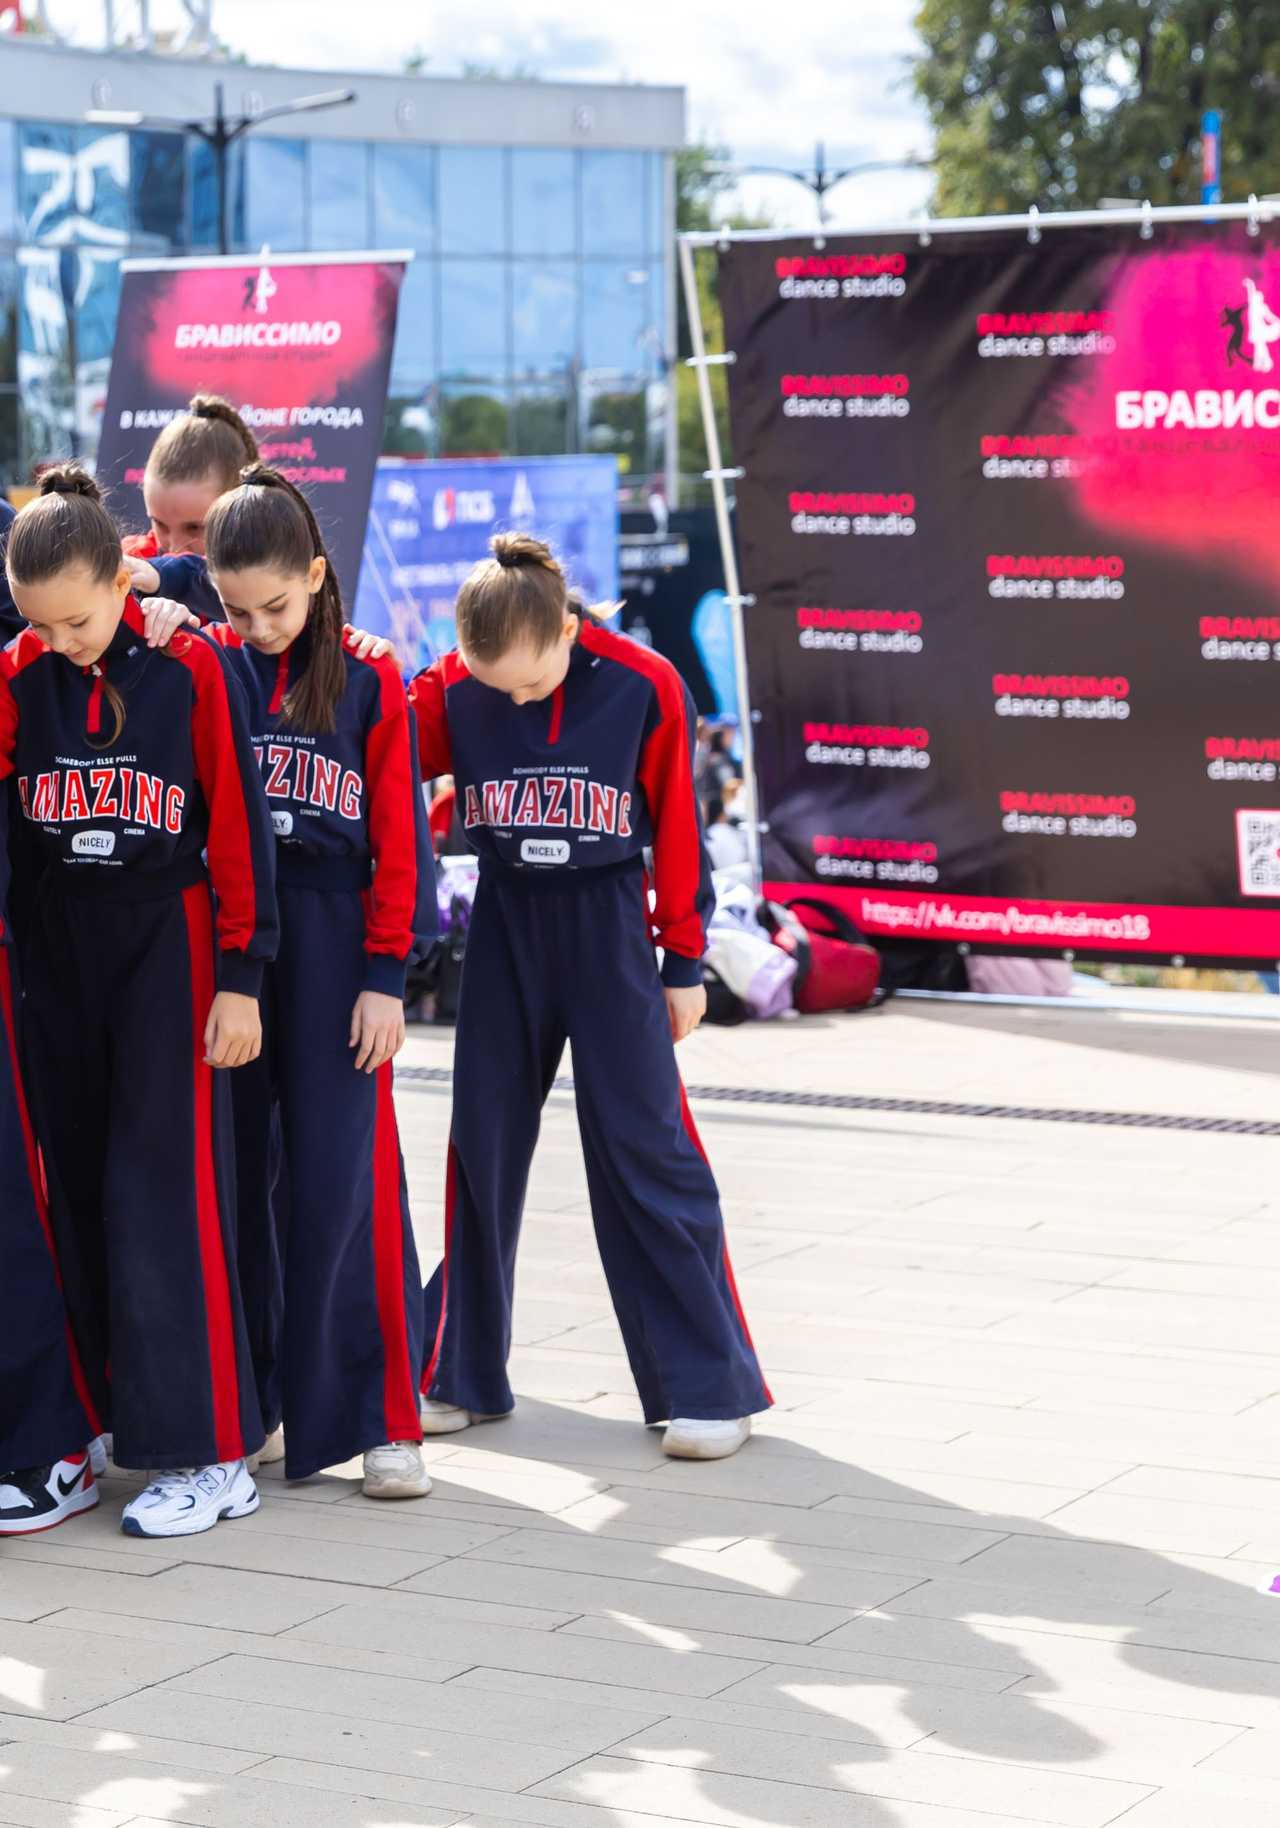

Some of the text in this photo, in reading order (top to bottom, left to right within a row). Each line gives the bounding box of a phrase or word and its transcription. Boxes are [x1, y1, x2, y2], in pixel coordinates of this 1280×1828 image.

[779, 275, 906, 299] dance studio
[174, 320, 342, 348] БРАВИССИМО
[978, 332, 1117, 357] dance studio
[120, 410, 133, 429] В
[238, 403, 289, 427] ЙОНЕ
[288, 406, 364, 430] ГОРОДА
[783, 393, 910, 417] dance studio
[1115, 388, 1280, 430] БРАВИС
[982, 455, 1049, 479] dance
[791, 511, 916, 536] dance studio
[988, 574, 1125, 600] dance studio
[799, 626, 923, 653] dance studio
[1201, 635, 1271, 661] dance
[994, 693, 1131, 720] dance studio
[276, 735, 293, 743] ELSE
[294, 736, 316, 745] PULLS
[96, 757, 114, 766] ELSE
[115, 755, 137, 763] PULLS
[806, 742, 931, 769] dance studio
[253, 744, 363, 820] ZING
[549, 766, 566, 774] ELSE
[566, 766, 589, 774] PULLS
[1207, 756, 1277, 782] dance
[18, 768, 185, 834] AMAZING
[464, 776, 633, 837] AMAZING
[123, 828, 146, 836] CINEMA
[1002, 809, 1137, 838] dance studio
[79, 836, 112, 849] NICELY
[527, 845, 564, 856] NICELY
[815, 854, 939, 883] dance studio
[861, 897, 1151, 940] https://vk.com/bravissimo18
